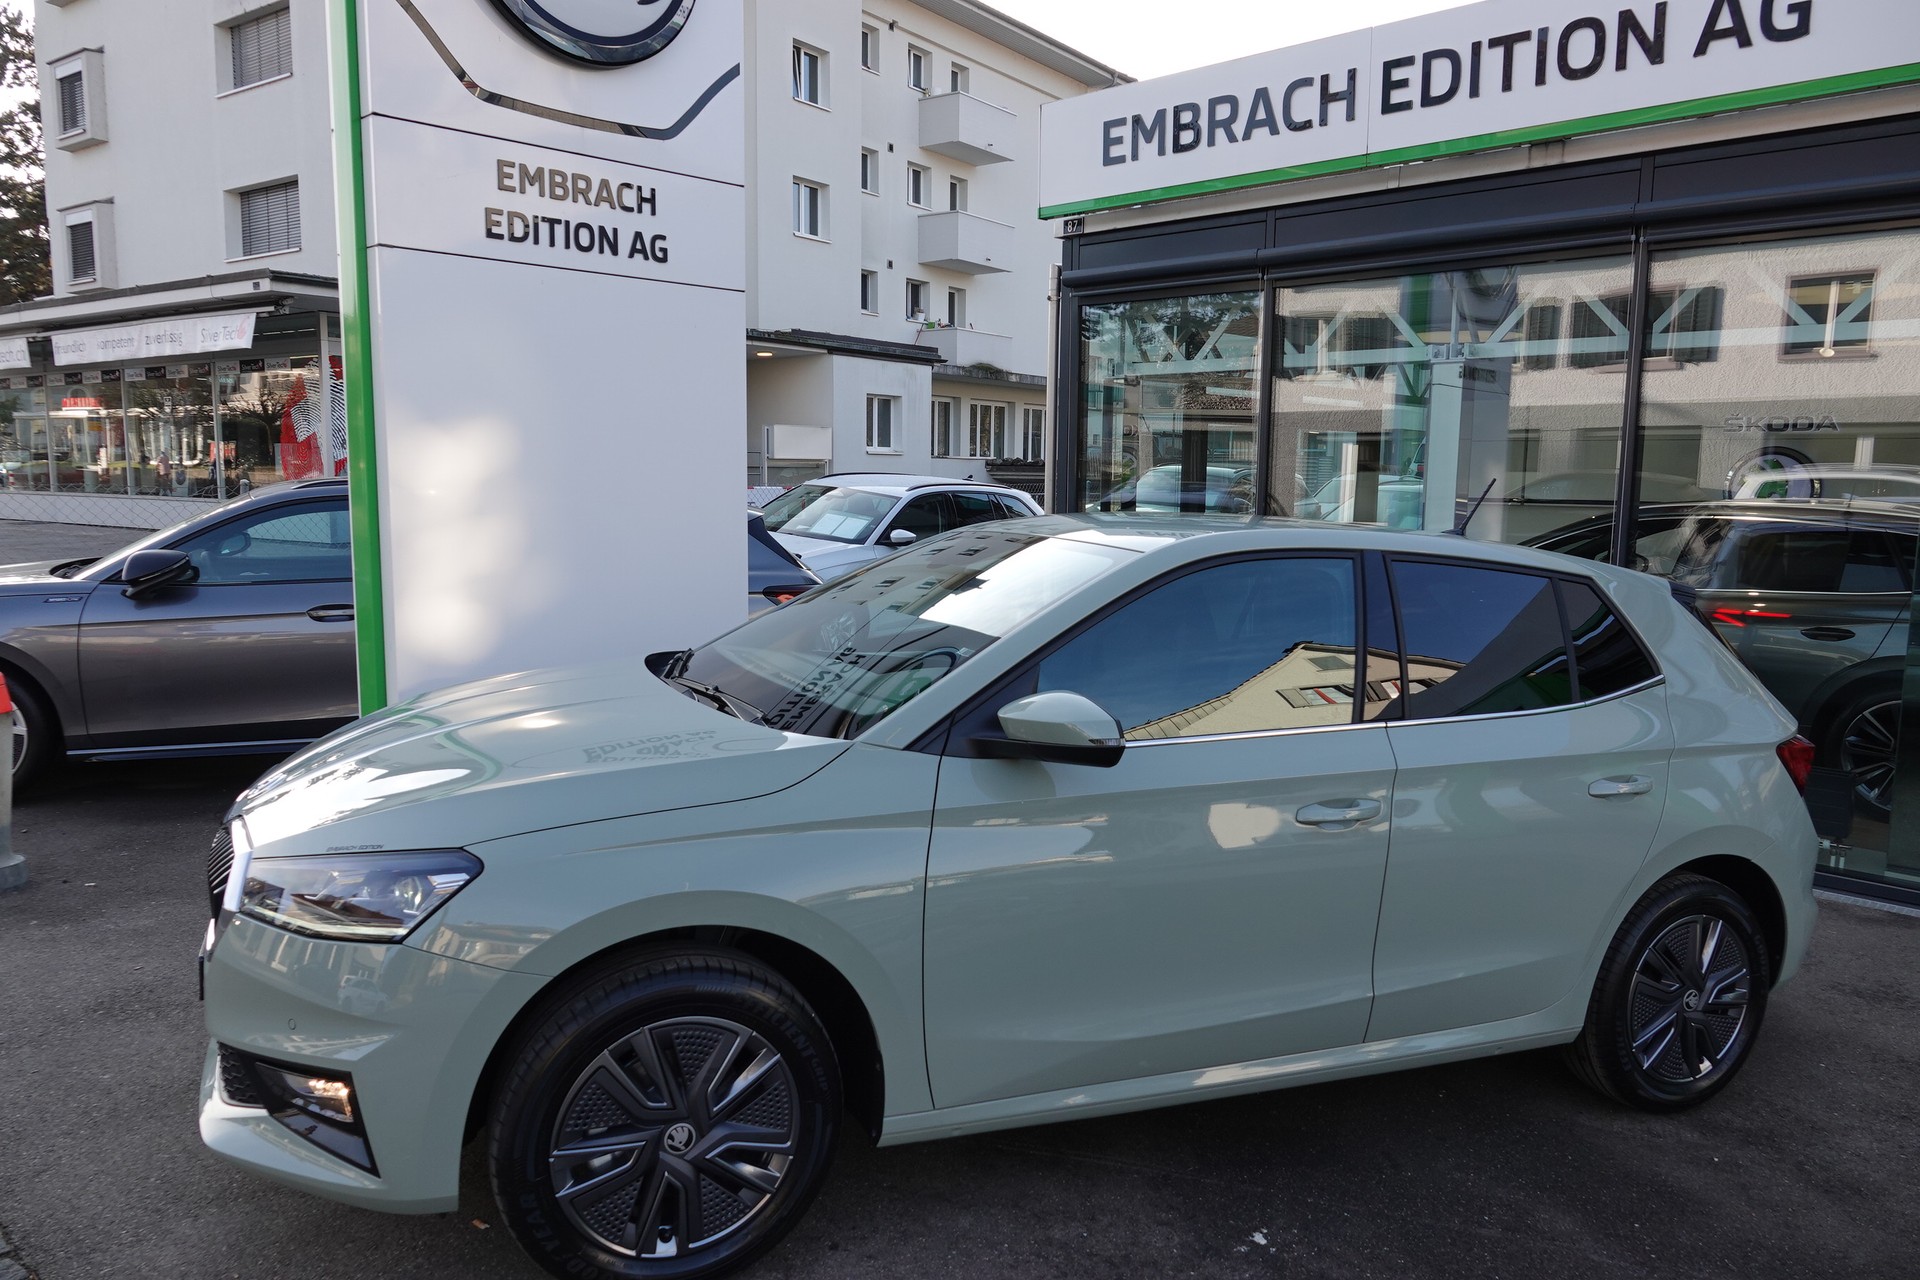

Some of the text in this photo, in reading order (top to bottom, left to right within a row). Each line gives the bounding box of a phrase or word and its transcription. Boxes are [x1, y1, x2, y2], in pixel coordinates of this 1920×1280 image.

[1102, 0, 1812, 167] EMBRACH EDITION AG
[497, 159, 657, 216] EMBRACH
[485, 207, 668, 263] EDITION AG
[1067, 220, 1078, 233] 87
[1723, 413, 1840, 433] ŠKODA
